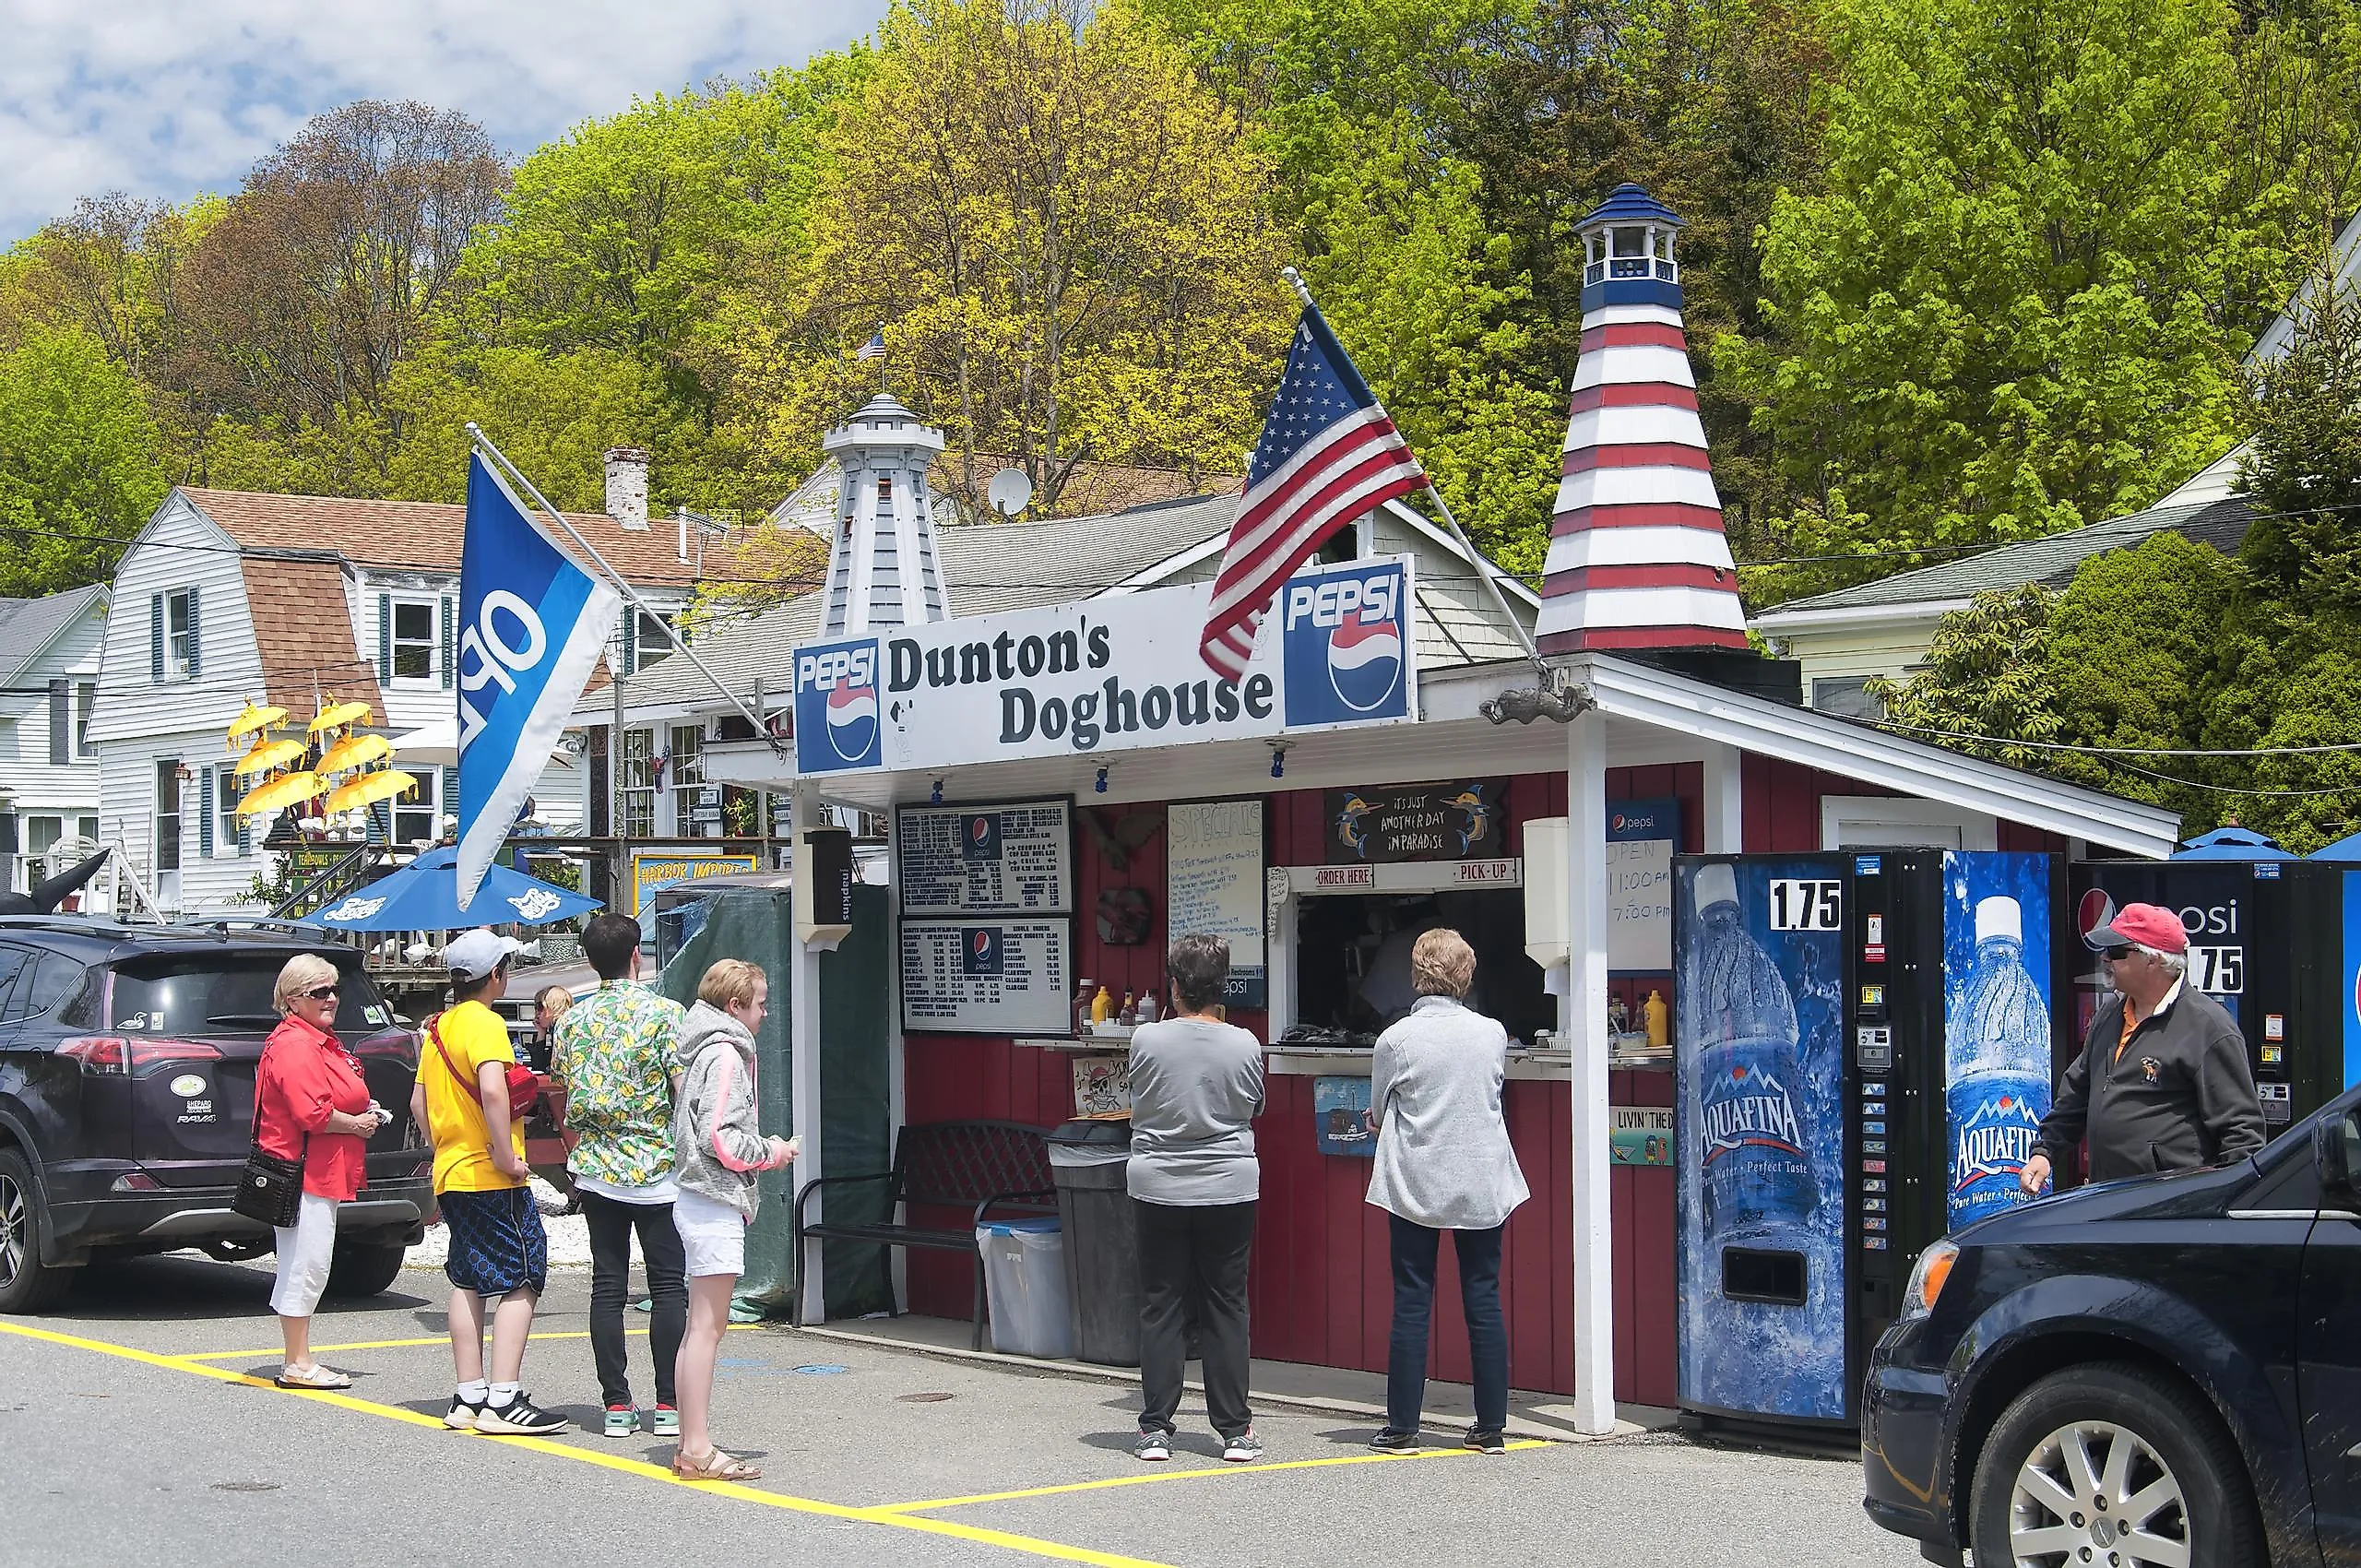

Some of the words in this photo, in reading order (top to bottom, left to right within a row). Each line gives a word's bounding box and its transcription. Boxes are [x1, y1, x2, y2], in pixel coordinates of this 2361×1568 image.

[1287, 574, 1399, 632] PEPSI
[887, 616, 1110, 693] Dunton's
[797, 647, 876, 694] PEPSI
[1000, 672, 1275, 750] Doghouse
[1407, 794, 1429, 810] JUST
[1174, 803, 1262, 843] SPECIALS
[1381, 813, 1423, 832] ANOTHER
[1426, 811, 1445, 826] DAY
[1627, 815, 1654, 830] pepsi
[640, 862, 688, 885] HARBOR
[1317, 870, 1345, 885] ORDER
[1347, 869, 1370, 884] HERE
[1608, 872, 1652, 896] 11:00
[1655, 873, 1669, 884] AM
[840, 872, 851, 921] napkins
[1773, 882, 1840, 930] 1.75
[1614, 906, 1651, 921] 7:00
[1655, 907, 1670, 920] PM
[975, 962, 991, 971] pepsi
[1223, 978, 1248, 996] epsi
[176, 1114, 217, 1123] RAV4
[1618, 1111, 1648, 1129] LIVIN'
[1649, 1111, 1667, 1128] THE
[1700, 1086, 1803, 1167] AQUAFINA
[1954, 1122, 2040, 1189] AQUAFIN
[1714, 1166, 1738, 1181] Water
[1746, 1160, 1782, 1175] Perfect
[1784, 1160, 1808, 1174] Taste
[1954, 1196, 1970, 1210] Pure
[1971, 1191, 1996, 1204] Water
